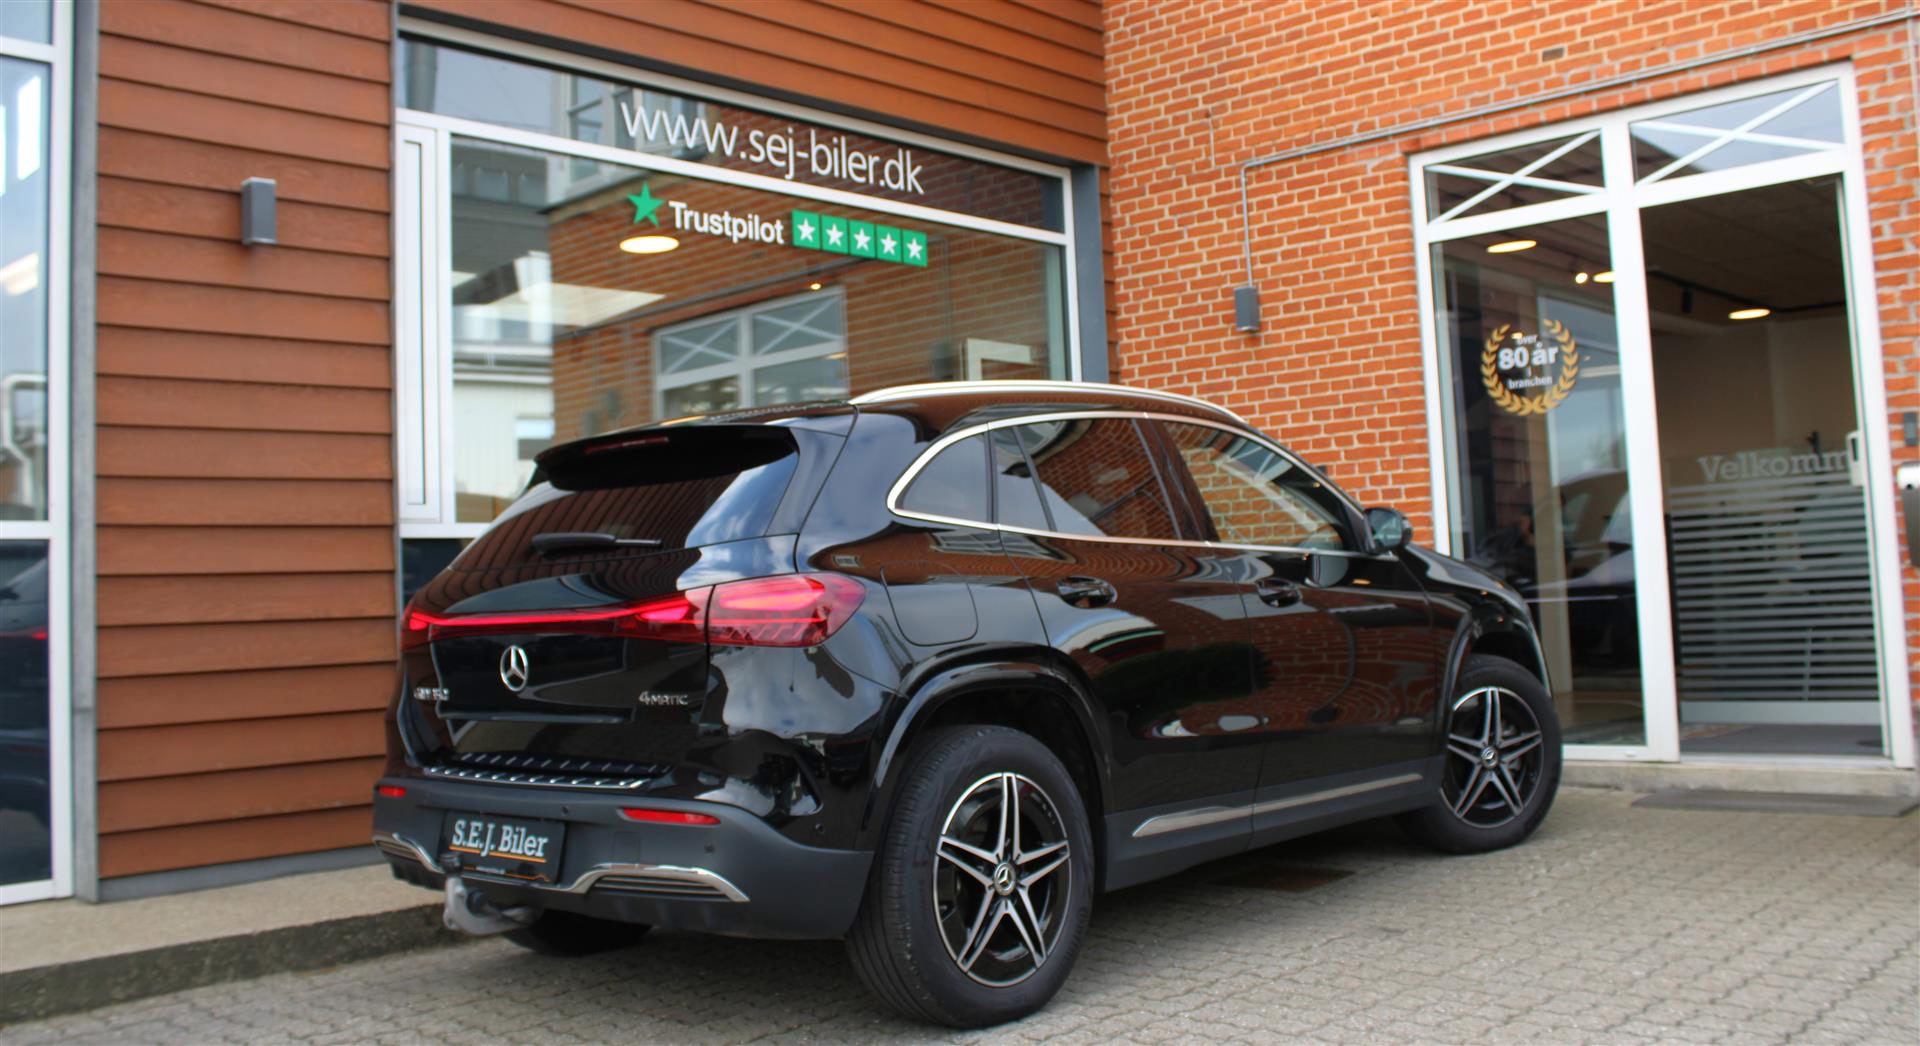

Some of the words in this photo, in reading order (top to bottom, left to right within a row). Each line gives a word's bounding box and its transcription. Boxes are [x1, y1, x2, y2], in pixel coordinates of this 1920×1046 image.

[621, 102, 925, 195] www.sej-biler.dk
[668, 200, 785, 245] Trustpilot
[1498, 346, 1530, 370] 80
[1532, 342, 1559, 366] år
[1508, 376, 1553, 390] branchen
[451, 819, 497, 857] S.E.J.
[498, 824, 549, 857] Biler
